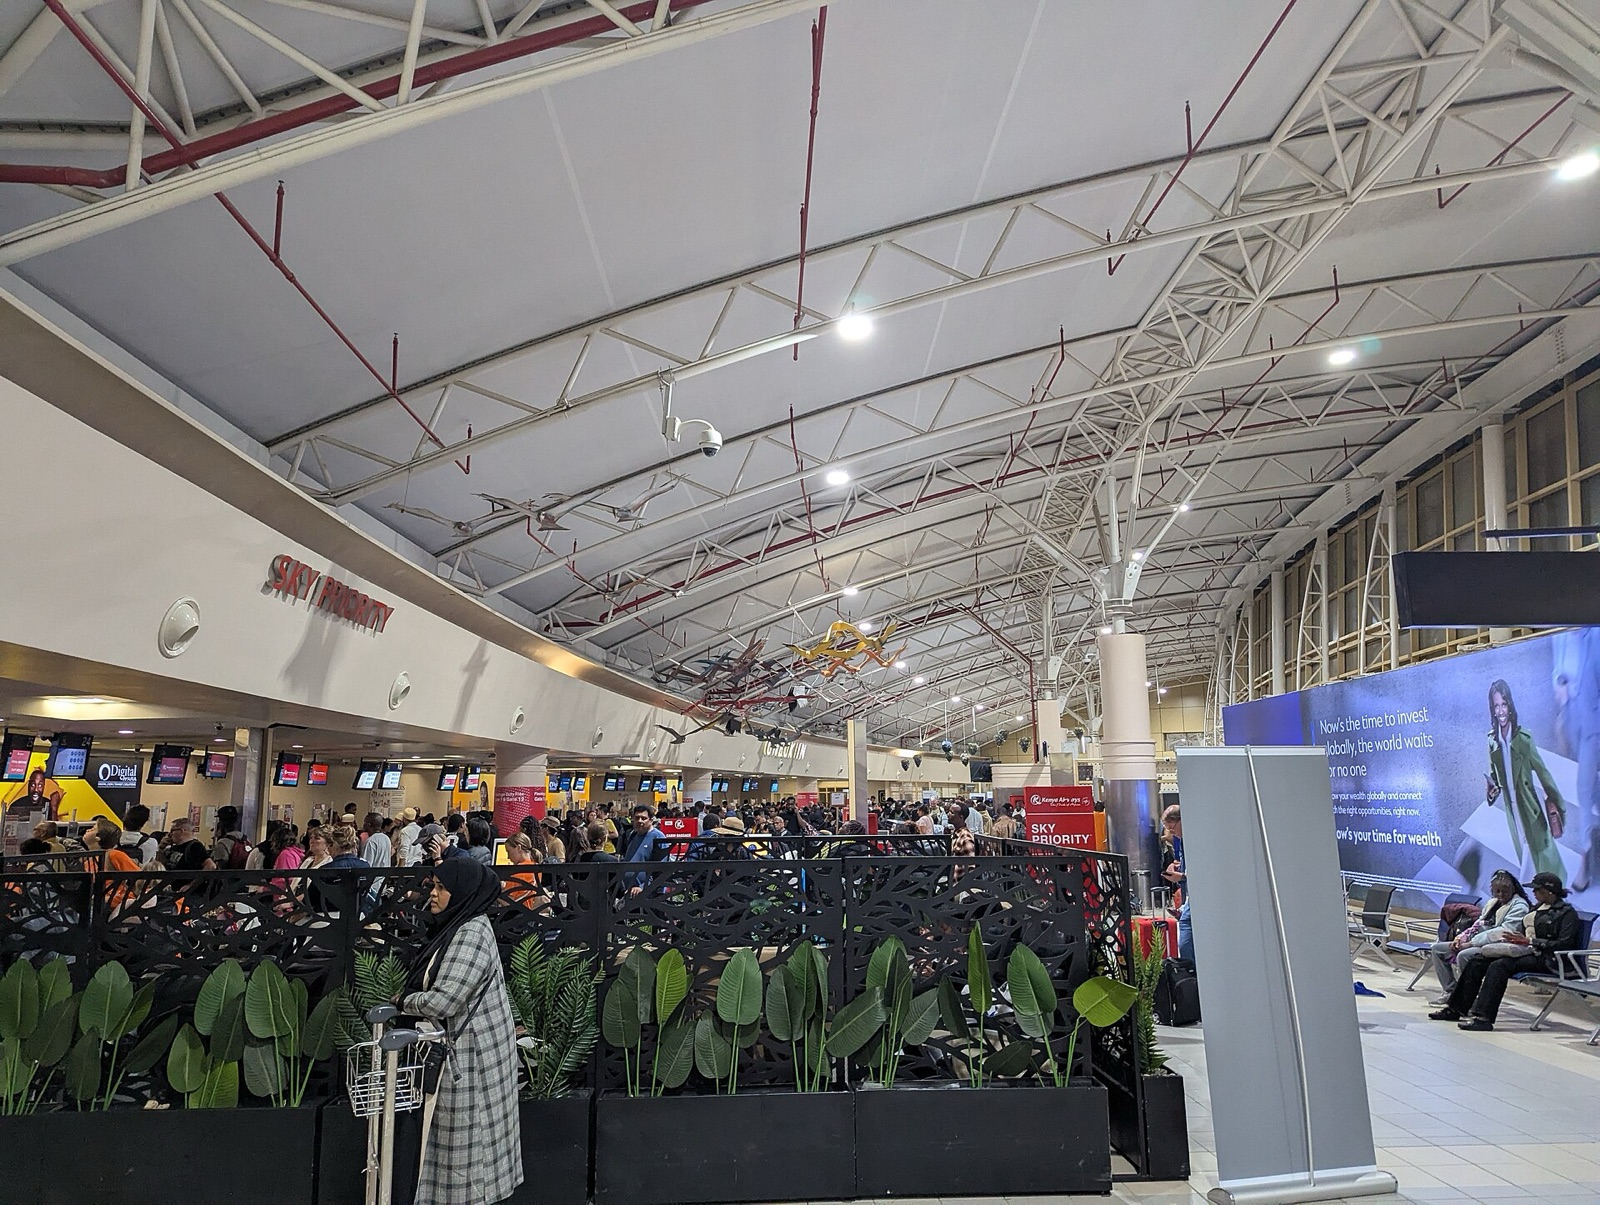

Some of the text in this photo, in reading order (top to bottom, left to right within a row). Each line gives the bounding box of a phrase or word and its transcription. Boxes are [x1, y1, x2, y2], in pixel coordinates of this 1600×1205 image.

[272, 555, 395, 633] SKY PRIORITY
[1320, 706, 1429, 735] Now's the time to invest
[1358, 736, 1373, 753] the
[1374, 733, 1403, 752] world
[1404, 732, 1434, 749] waits
[111, 764, 137, 777] Digital
[1337, 766, 1349, 777] no
[1350, 765, 1367, 777] one
[1349, 791, 1367, 800] wealth
[1367, 791, 1387, 802] globally
[1387, 791, 1399, 800] and
[1399, 791, 1422, 800] connect
[1347, 805, 1358, 817] right
[1358, 806, 1392, 817] opportunities,
[1393, 806, 1406, 818] right
[1406, 809, 1420, 817] now.
[1031, 823, 1056, 834] SKY
[1032, 834, 1090, 845] PRIORITY
[1336, 826, 1442, 847] ow's your time for wealth
